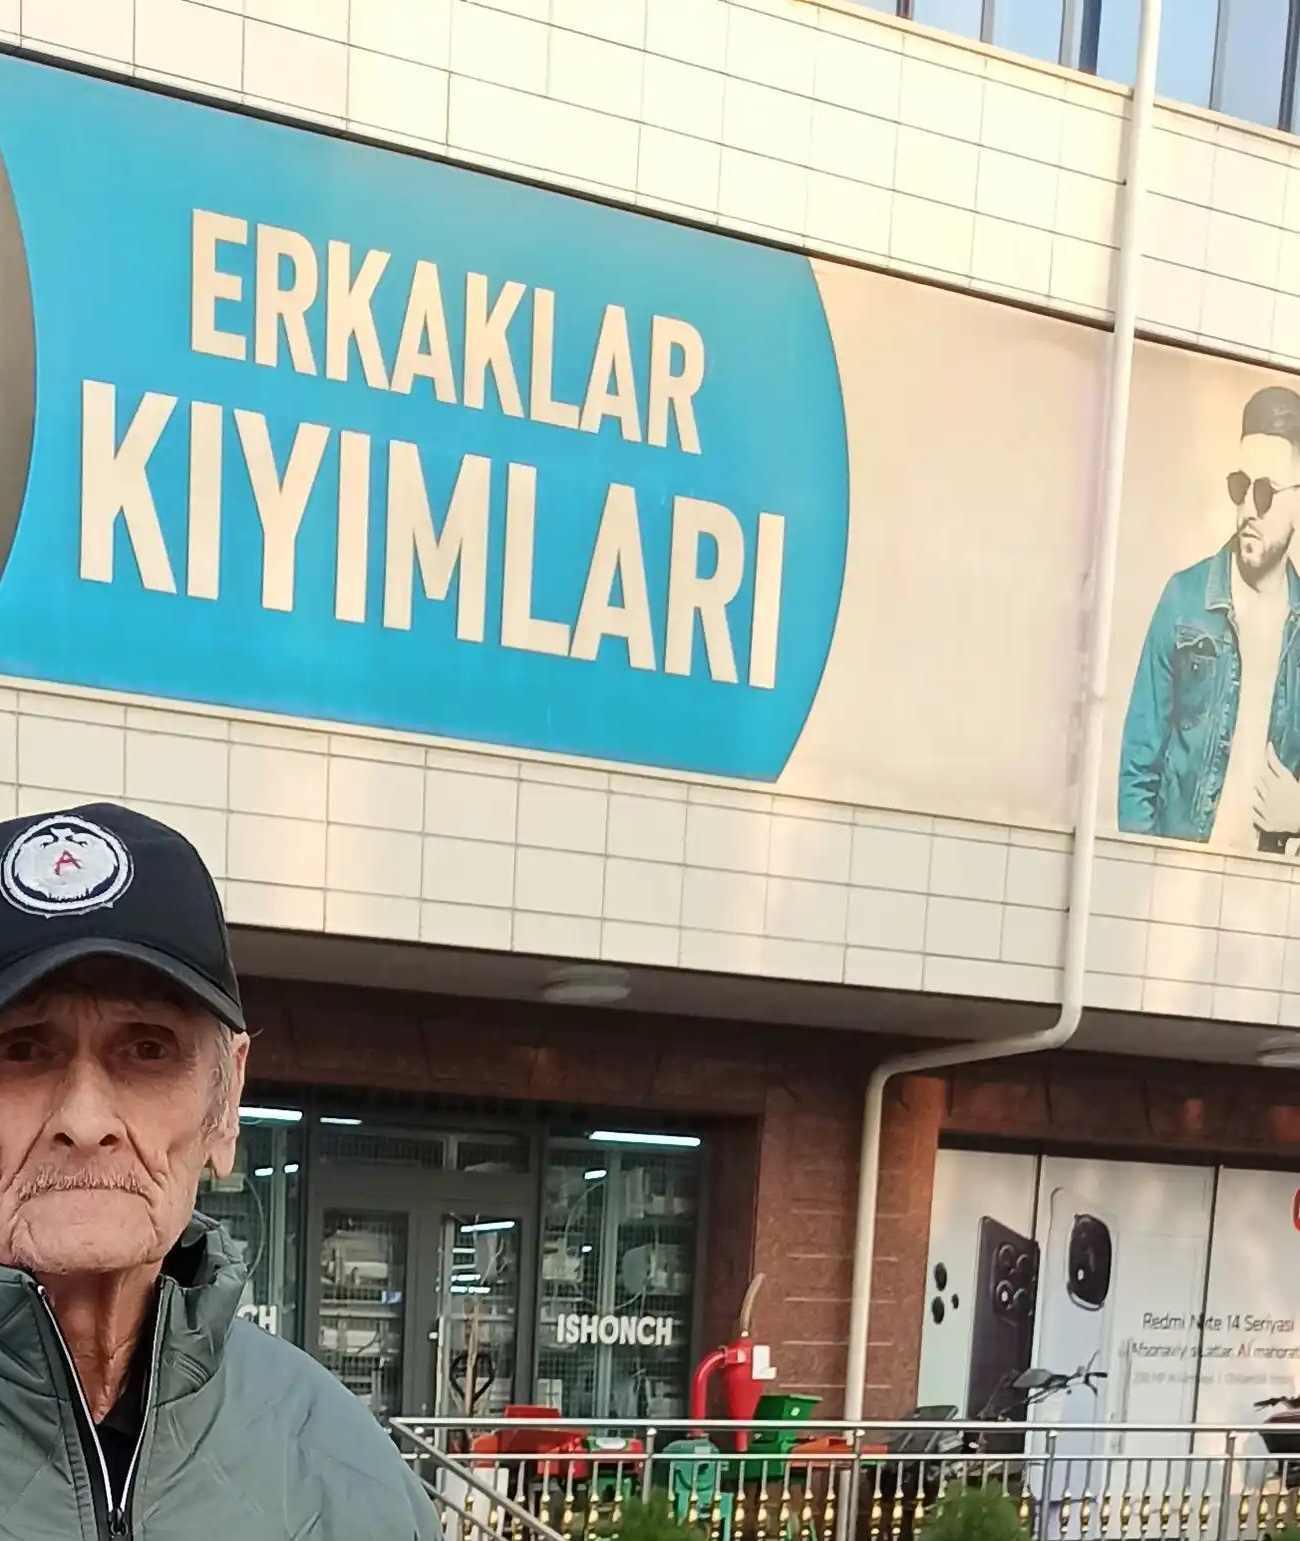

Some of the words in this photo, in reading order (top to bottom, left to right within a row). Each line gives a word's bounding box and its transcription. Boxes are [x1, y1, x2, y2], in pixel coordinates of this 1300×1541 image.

[191, 208, 706, 455] ERKAKLAR
[79, 379, 786, 690] KIYIMLARI
[556, 1313, 674, 1345] ISHONCH
[1142, 1312, 1185, 1330] Redmi
[1226, 1314, 1241, 1330] 14
